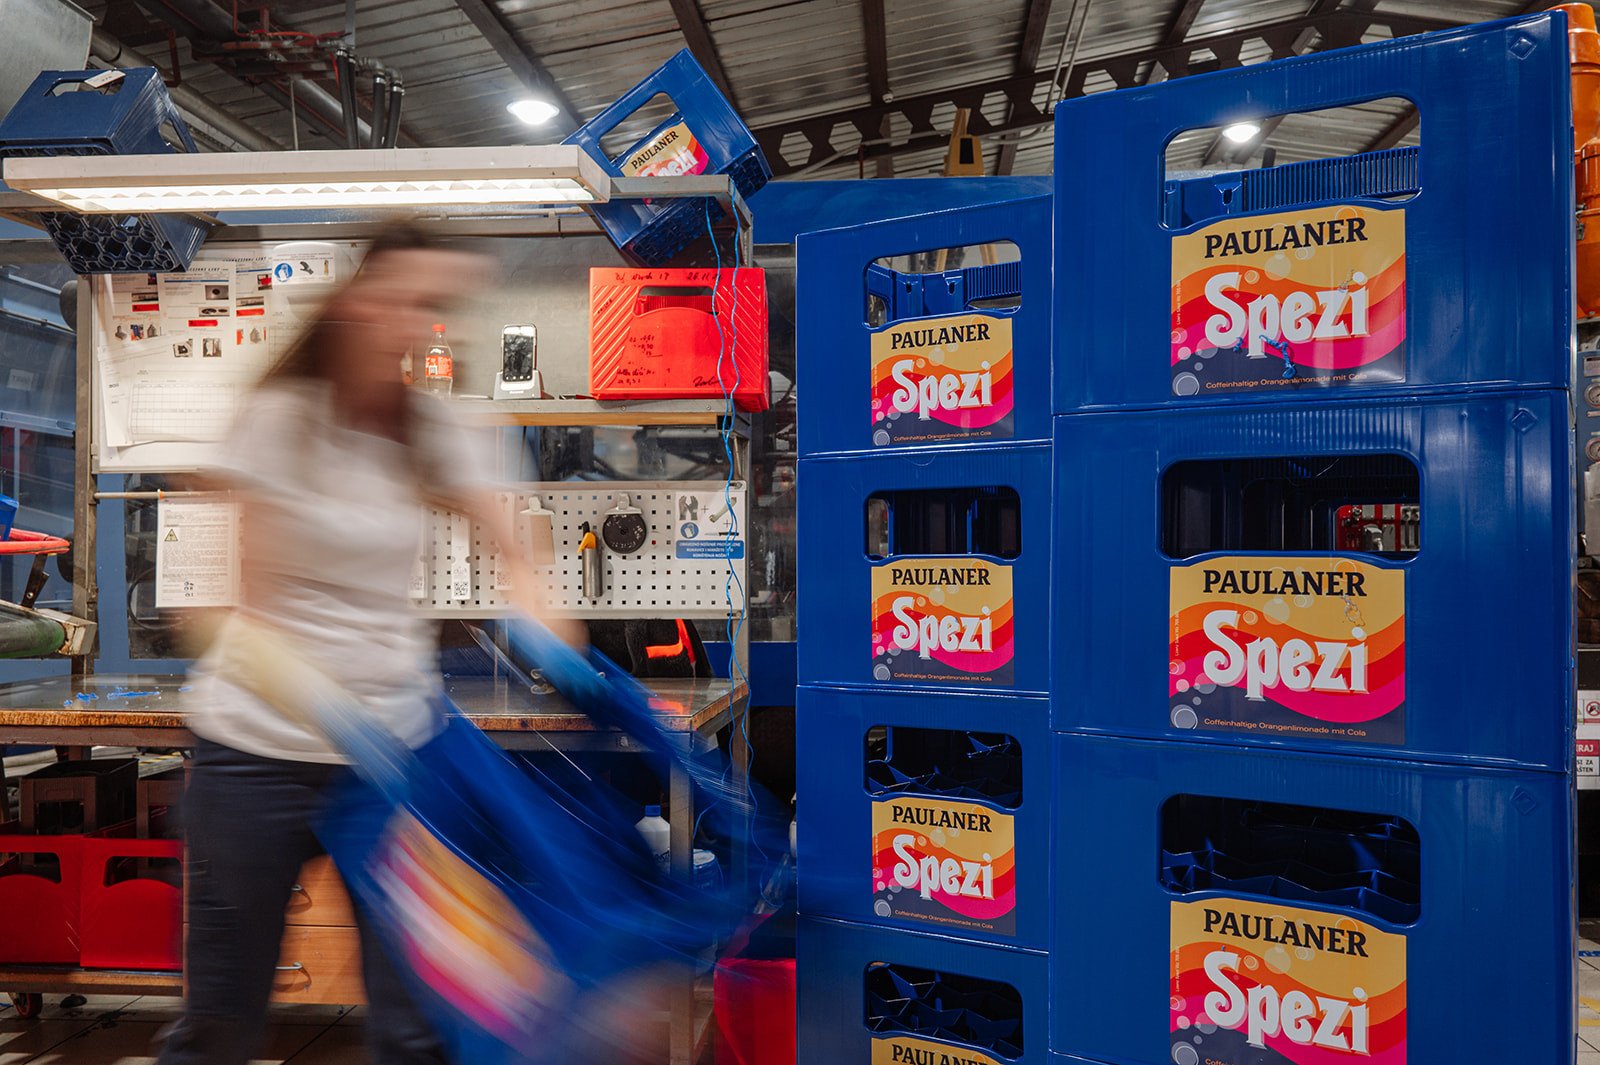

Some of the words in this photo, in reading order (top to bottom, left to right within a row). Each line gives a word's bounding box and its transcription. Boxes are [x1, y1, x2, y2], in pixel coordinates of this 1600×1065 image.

[630, 130, 679, 169] PAULANER
[1204, 217, 1368, 258] PAULANER
[1204, 271, 1371, 359] Spezi
[891, 323, 990, 349] PAULANER
[891, 359, 993, 420] Spezi
[1206, 379, 1258, 389] Coffeinhaltige
[1260, 375, 1330, 386] Orangenlimonade
[1348, 372, 1367, 380] Cola
[892, 568, 991, 586] PAULANER
[1203, 570, 1367, 596] PAULANER
[892, 596, 993, 660] Spezi
[1202, 610, 1370, 701] Spezi
[1204, 718, 1258, 728] Coffeinhaltige
[1258, 722, 1329, 734] Orangenlimonade
[1331, 727, 1345, 735] mit
[1347, 728, 1366, 736] Cola
[892, 806, 992, 832] PAULANER
[892, 834, 995, 900] Spezi
[1203, 908, 1369, 958] PAULANER
[1203, 950, 1371, 1056] Spezi
